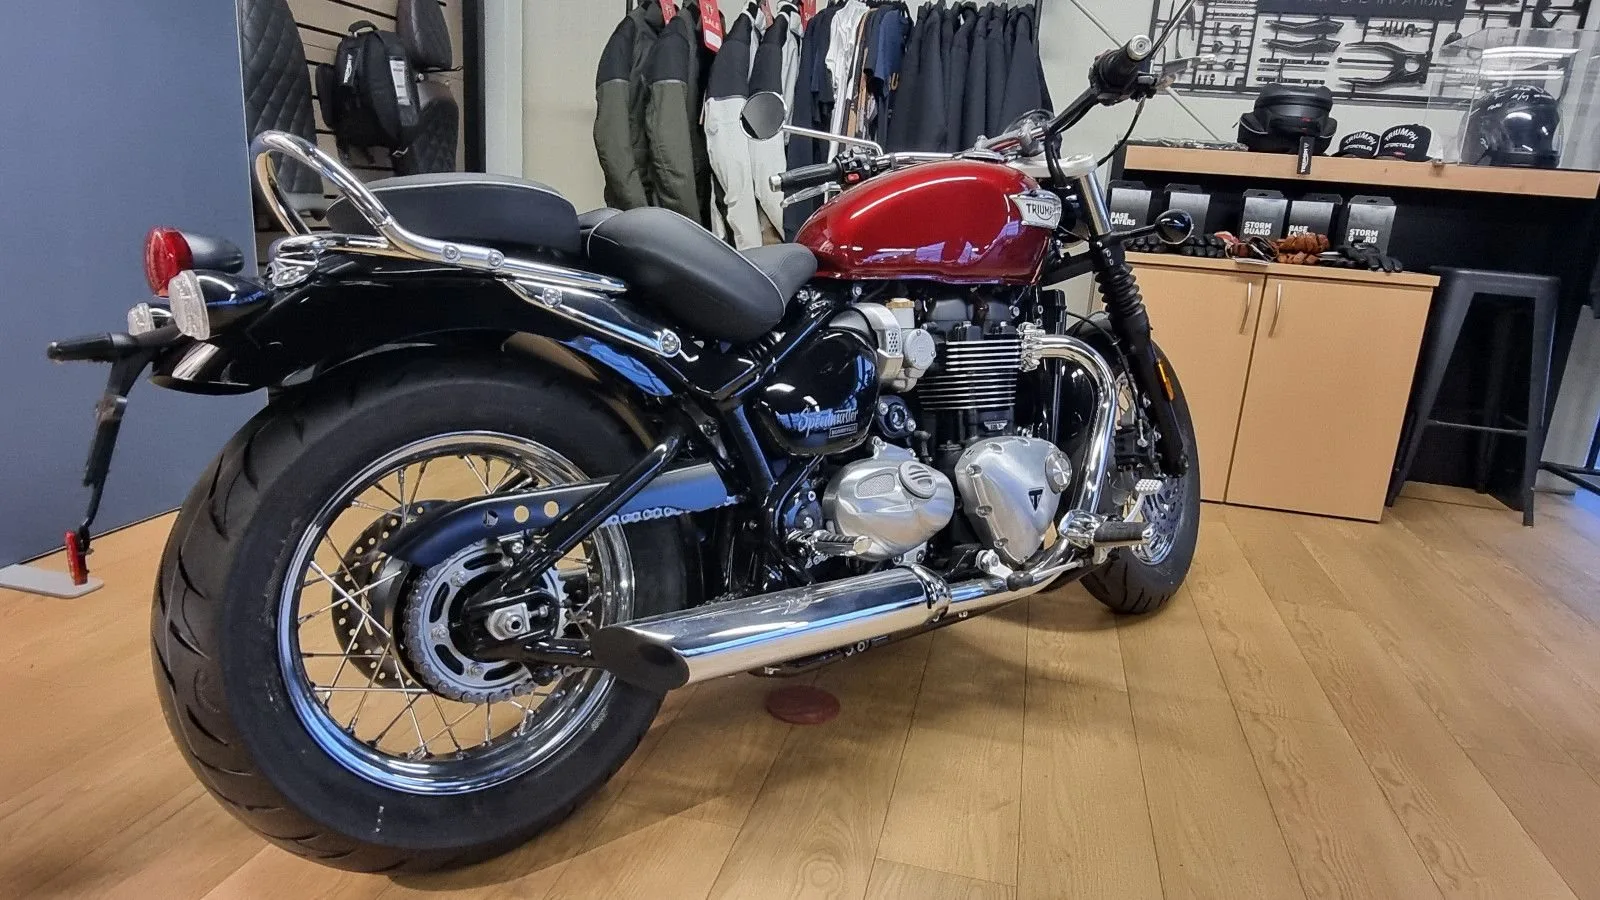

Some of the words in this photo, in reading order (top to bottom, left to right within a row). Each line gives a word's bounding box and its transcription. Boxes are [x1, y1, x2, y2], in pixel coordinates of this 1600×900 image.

[1345, 132, 1377, 145] TRIUMPH
[1384, 128, 1419, 142] TRIUMPH
[1110, 212, 1129, 220] BASE
[1110, 218, 1136, 226] LAYERS
[1244, 221, 1272, 229] STORM
[1243, 228, 1271, 236] GUARD
[1349, 228, 1379, 237] STORM
[1348, 235, 1377, 244] GRD
